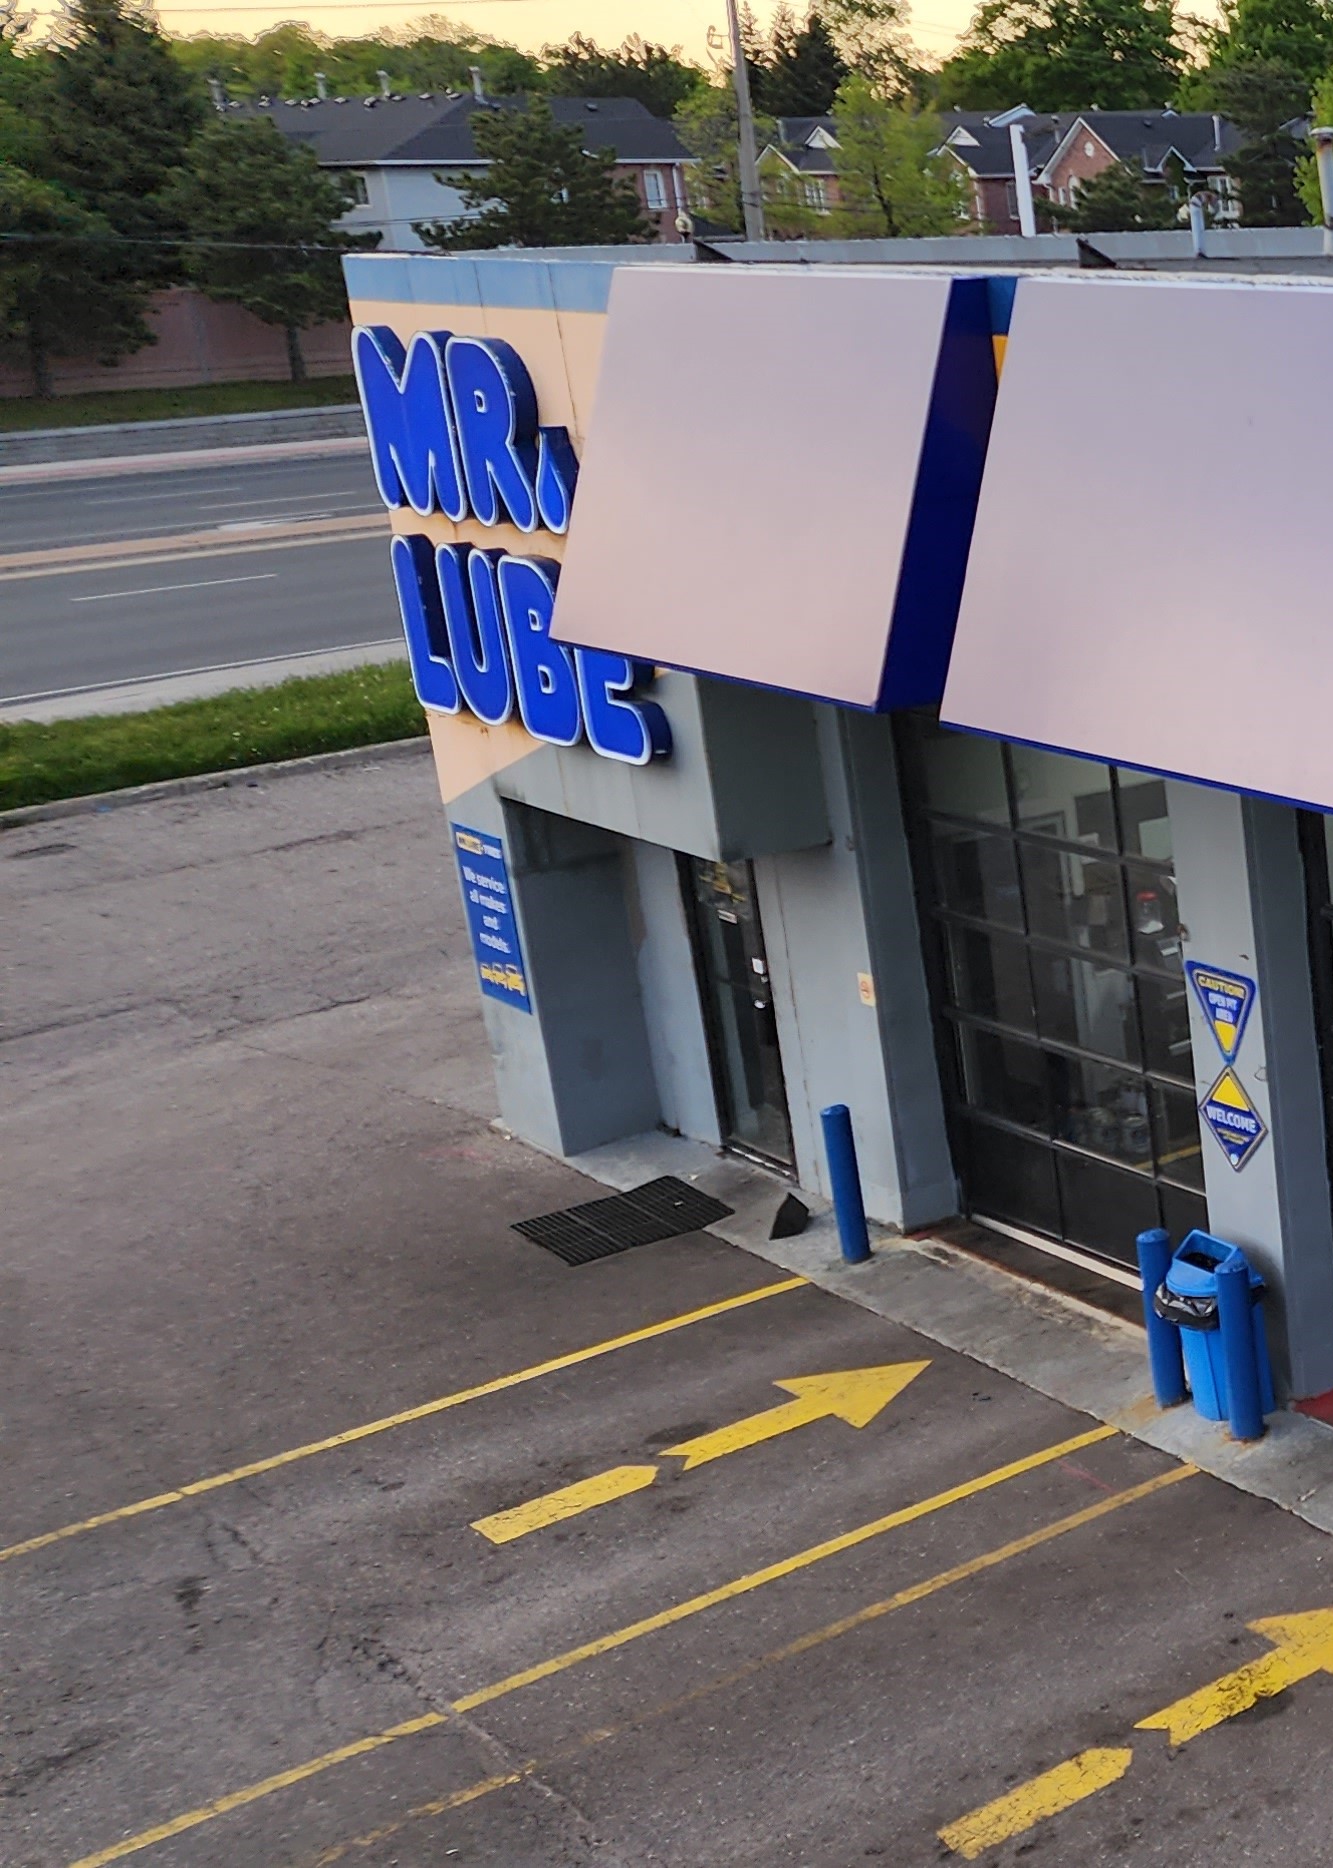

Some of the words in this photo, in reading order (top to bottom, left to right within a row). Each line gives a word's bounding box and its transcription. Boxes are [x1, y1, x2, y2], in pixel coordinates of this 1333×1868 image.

[350, 324, 575, 533] MR.
[390, 534, 668, 766] LUBE
[1206, 1104, 1257, 1134] WELCOME
